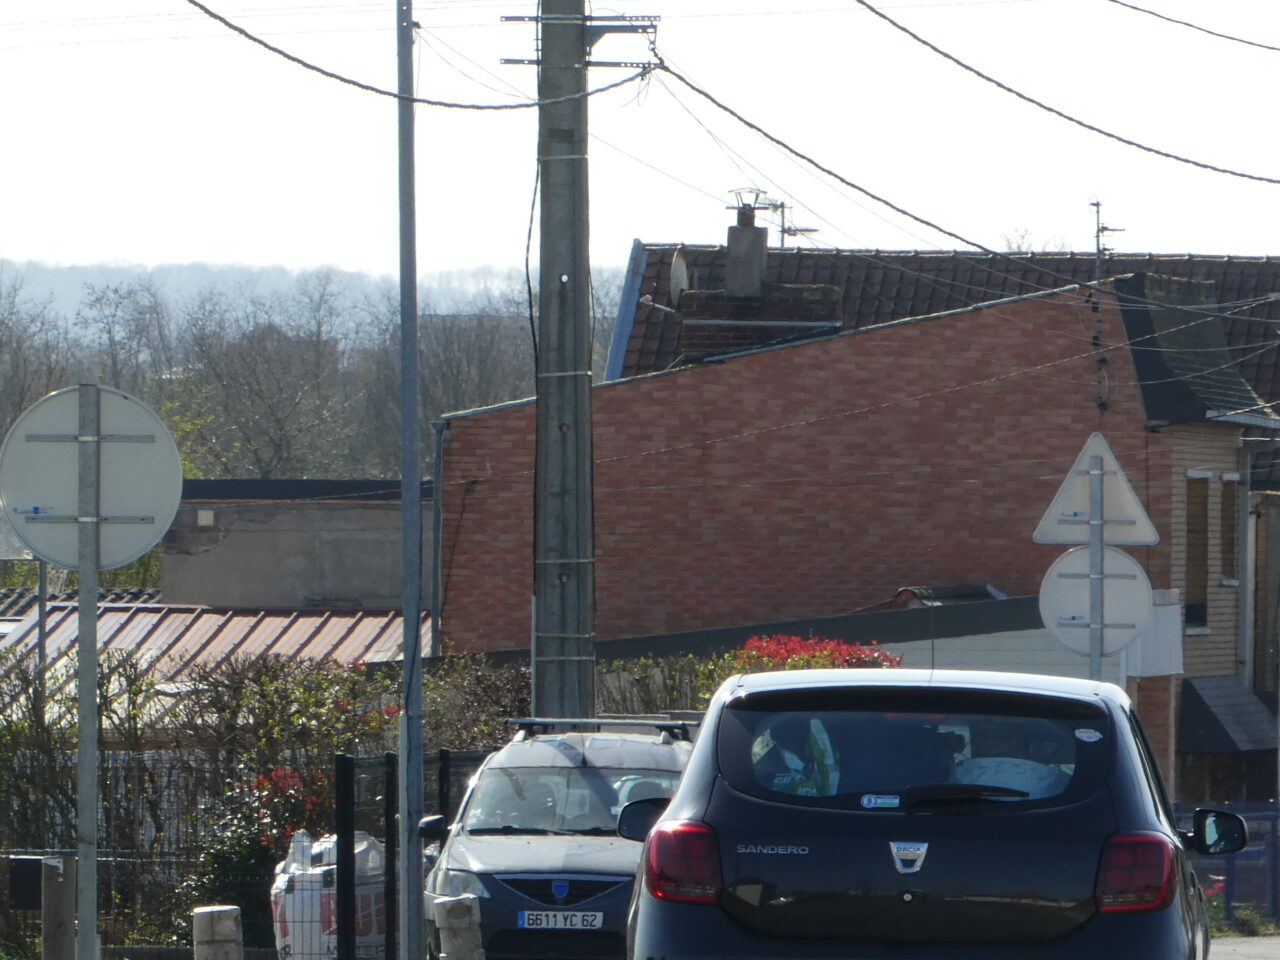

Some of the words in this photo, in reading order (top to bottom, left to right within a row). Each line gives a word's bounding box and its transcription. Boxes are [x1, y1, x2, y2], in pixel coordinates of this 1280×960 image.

[736, 844, 809, 855] SANDERO
[527, 913, 558, 927] 6611
[563, 913, 578, 927] YC
[582, 913, 597, 927] 62
